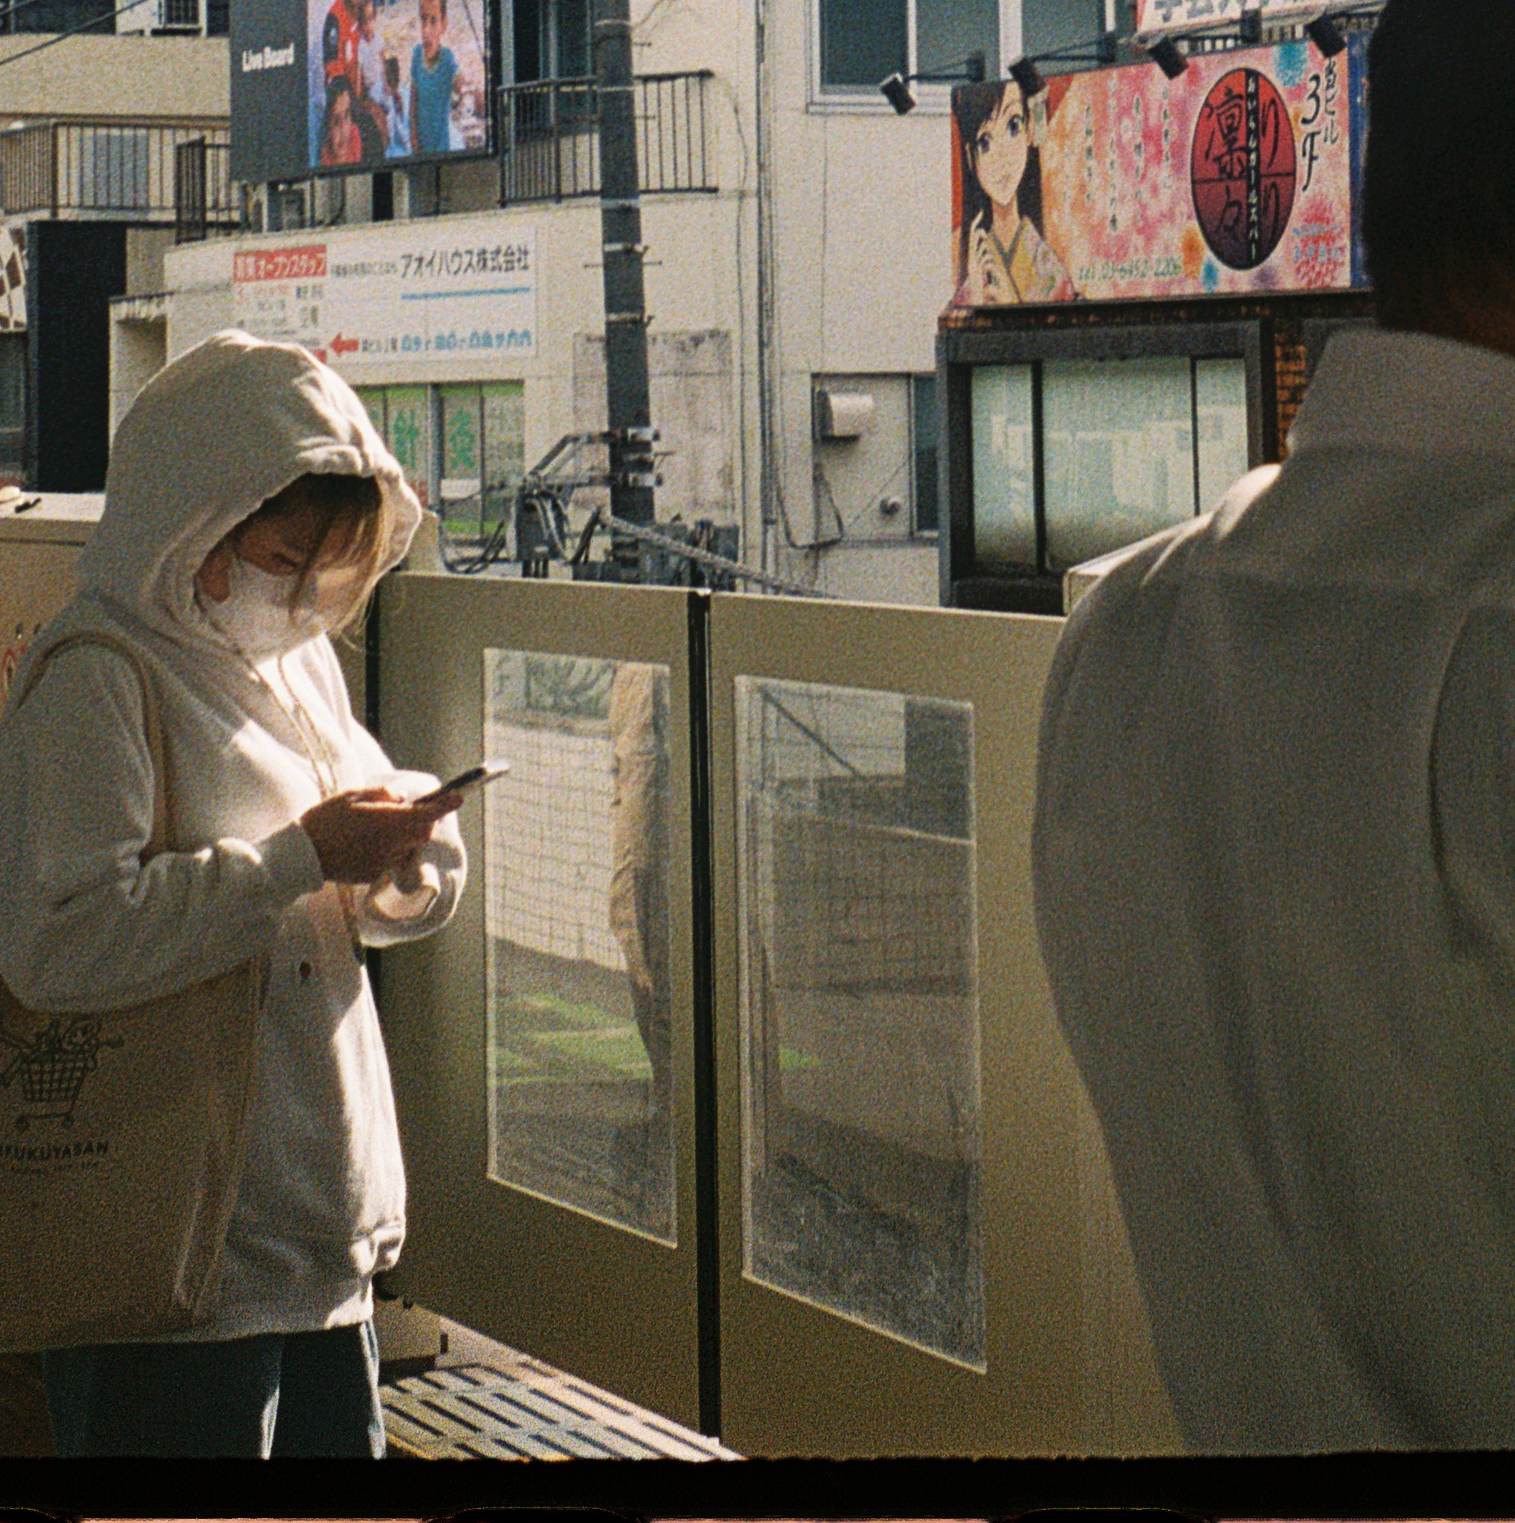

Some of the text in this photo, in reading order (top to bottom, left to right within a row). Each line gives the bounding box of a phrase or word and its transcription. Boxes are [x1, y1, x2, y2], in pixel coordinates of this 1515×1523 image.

[401, 244, 530, 278] アオイハウス株式会社
